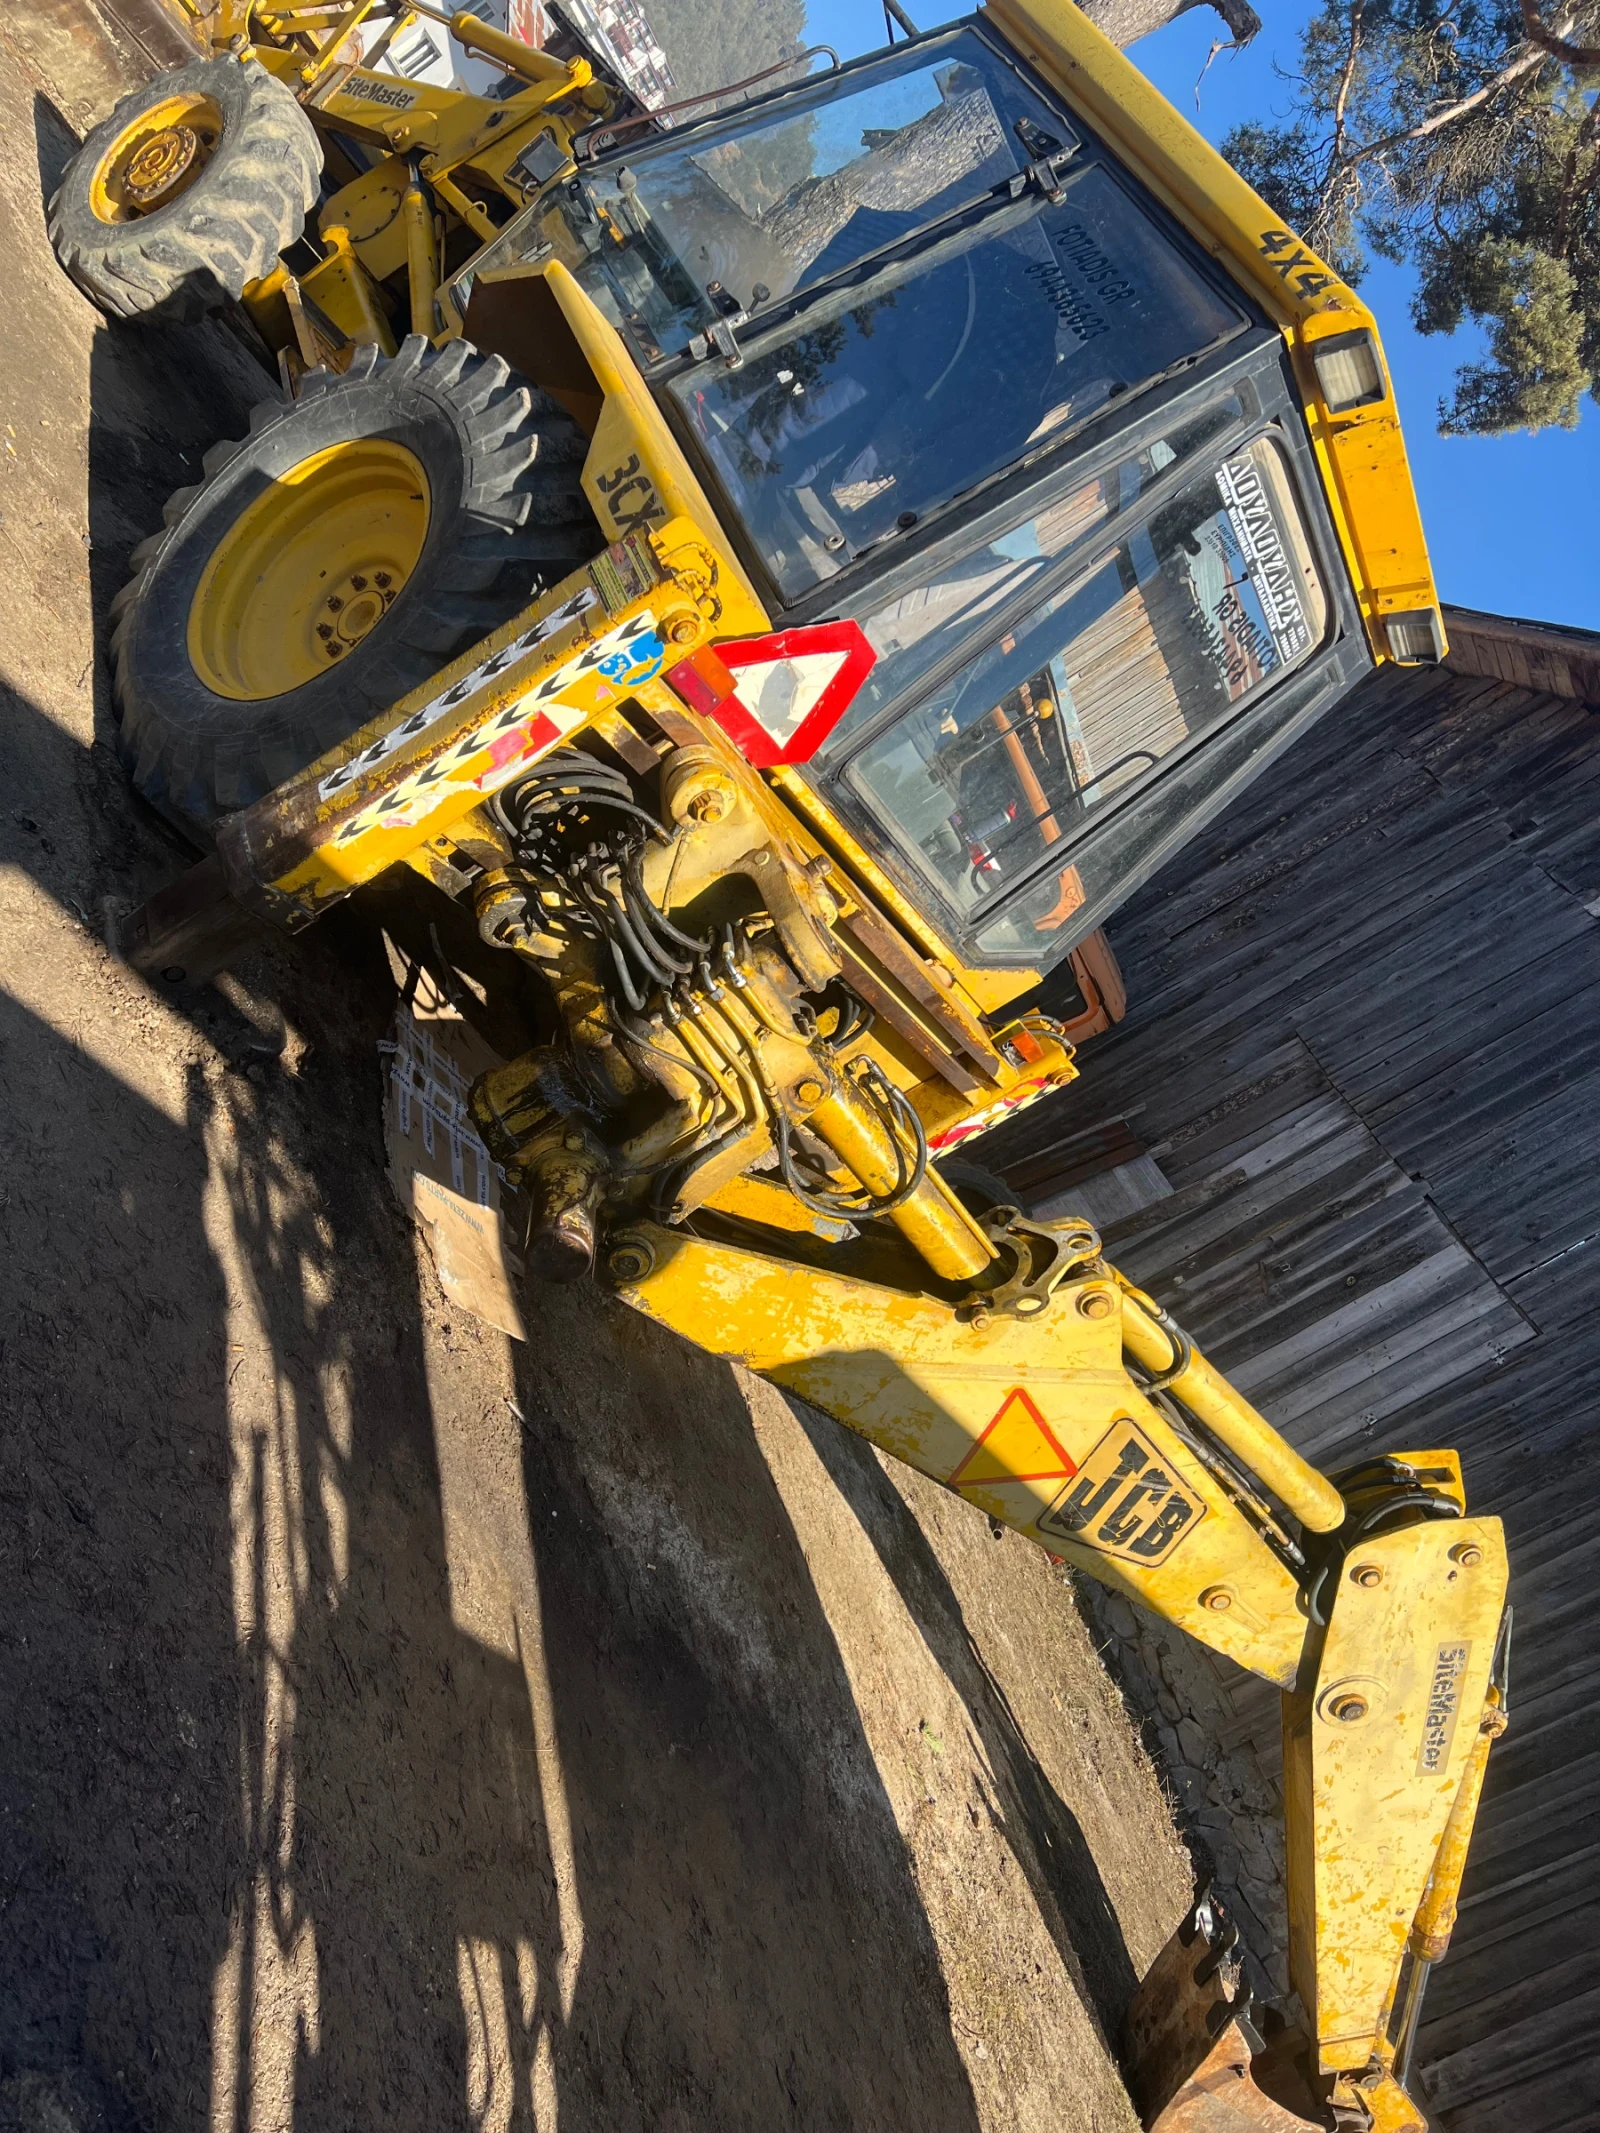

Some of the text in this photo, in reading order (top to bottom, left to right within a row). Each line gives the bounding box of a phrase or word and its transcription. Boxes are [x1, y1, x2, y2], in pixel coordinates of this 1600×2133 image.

[340, 77, 415, 109] SiteMaster
[1051, 224, 1135, 305] FOTIADIS GR
[596, 453, 665, 535] 3CX
[1048, 1438, 1194, 1557] JCB
